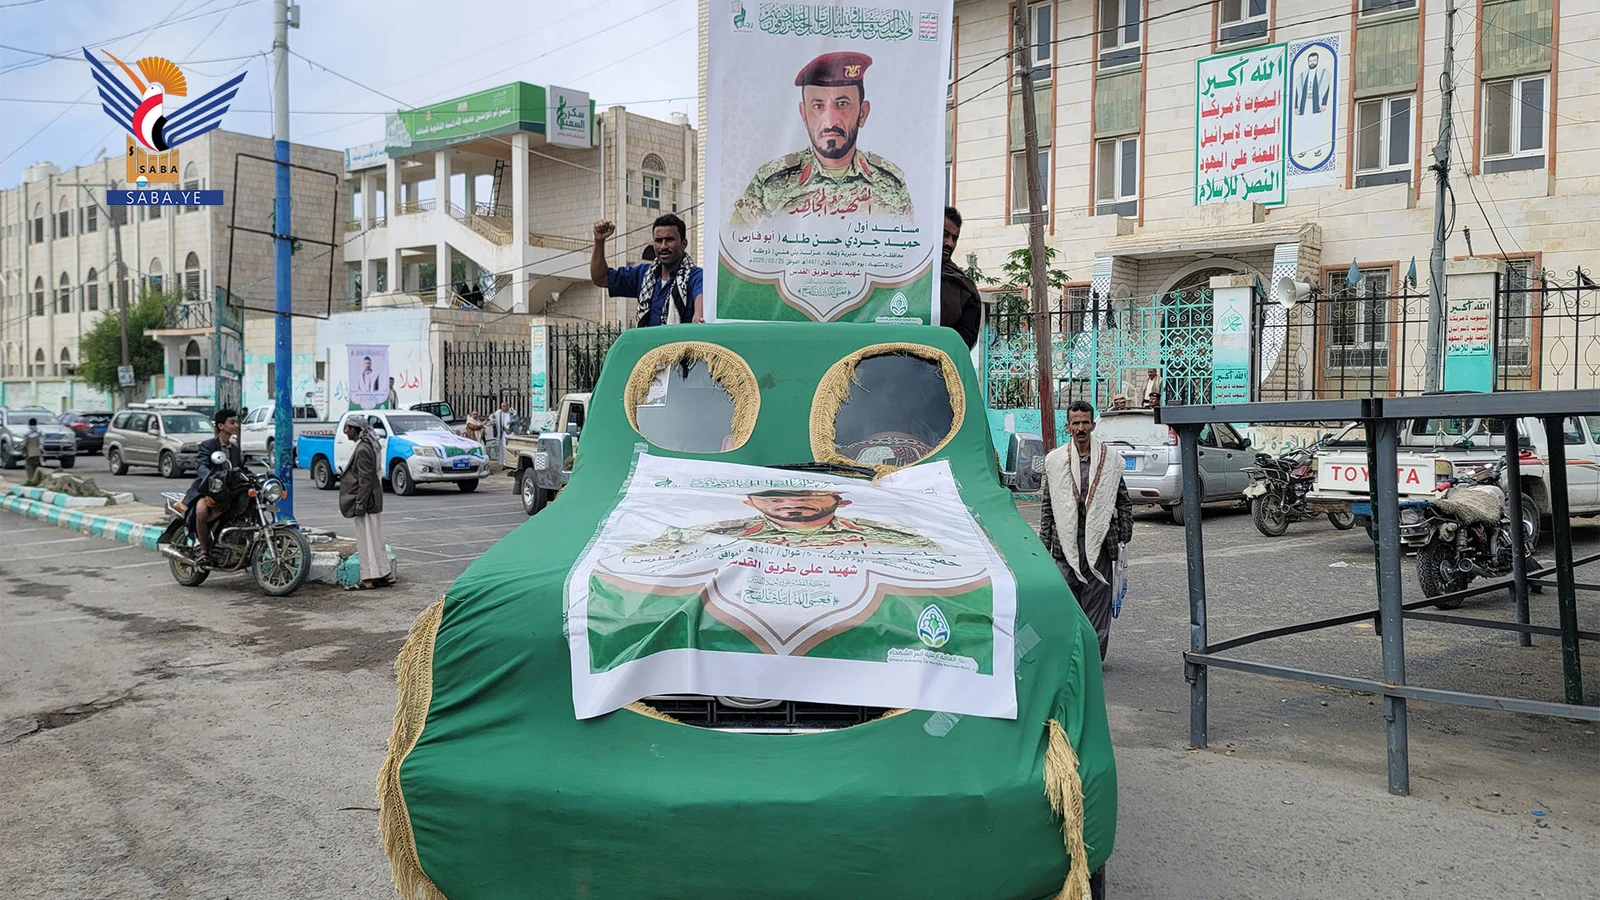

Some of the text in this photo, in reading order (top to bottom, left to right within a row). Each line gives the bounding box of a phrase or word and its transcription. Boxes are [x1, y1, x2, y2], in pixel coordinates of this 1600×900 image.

[1201, 55, 1282, 98] الله أكبر
[1244, 90, 1281, 116] الموت
[567, 107, 585, 119] سكر
[1243, 117, 1281, 141] الموت
[1200, 144, 1280, 174] اللعنة على اليهود
[1198, 167, 1279, 203] النصر للإسلام
[854, 220, 869, 233] أول
[872, 224, 920, 233] مساعد
[812, 233, 843, 247] حسن
[844, 235, 880, 249] جردي
[884, 237, 920, 250] حميد
[811, 268, 829, 277] طريق
[830, 269, 843, 277] على
[845, 269, 861, 277] شهيد
[1473, 300, 1489, 310] الله
[1234, 372, 1247, 380] الله
[1331, 466, 1421, 485] TOYTA
[782, 549, 801, 558] شوال
[764, 561, 797, 577] طريق
[799, 564, 824, 577] على
[828, 564, 858, 578] شهيد
